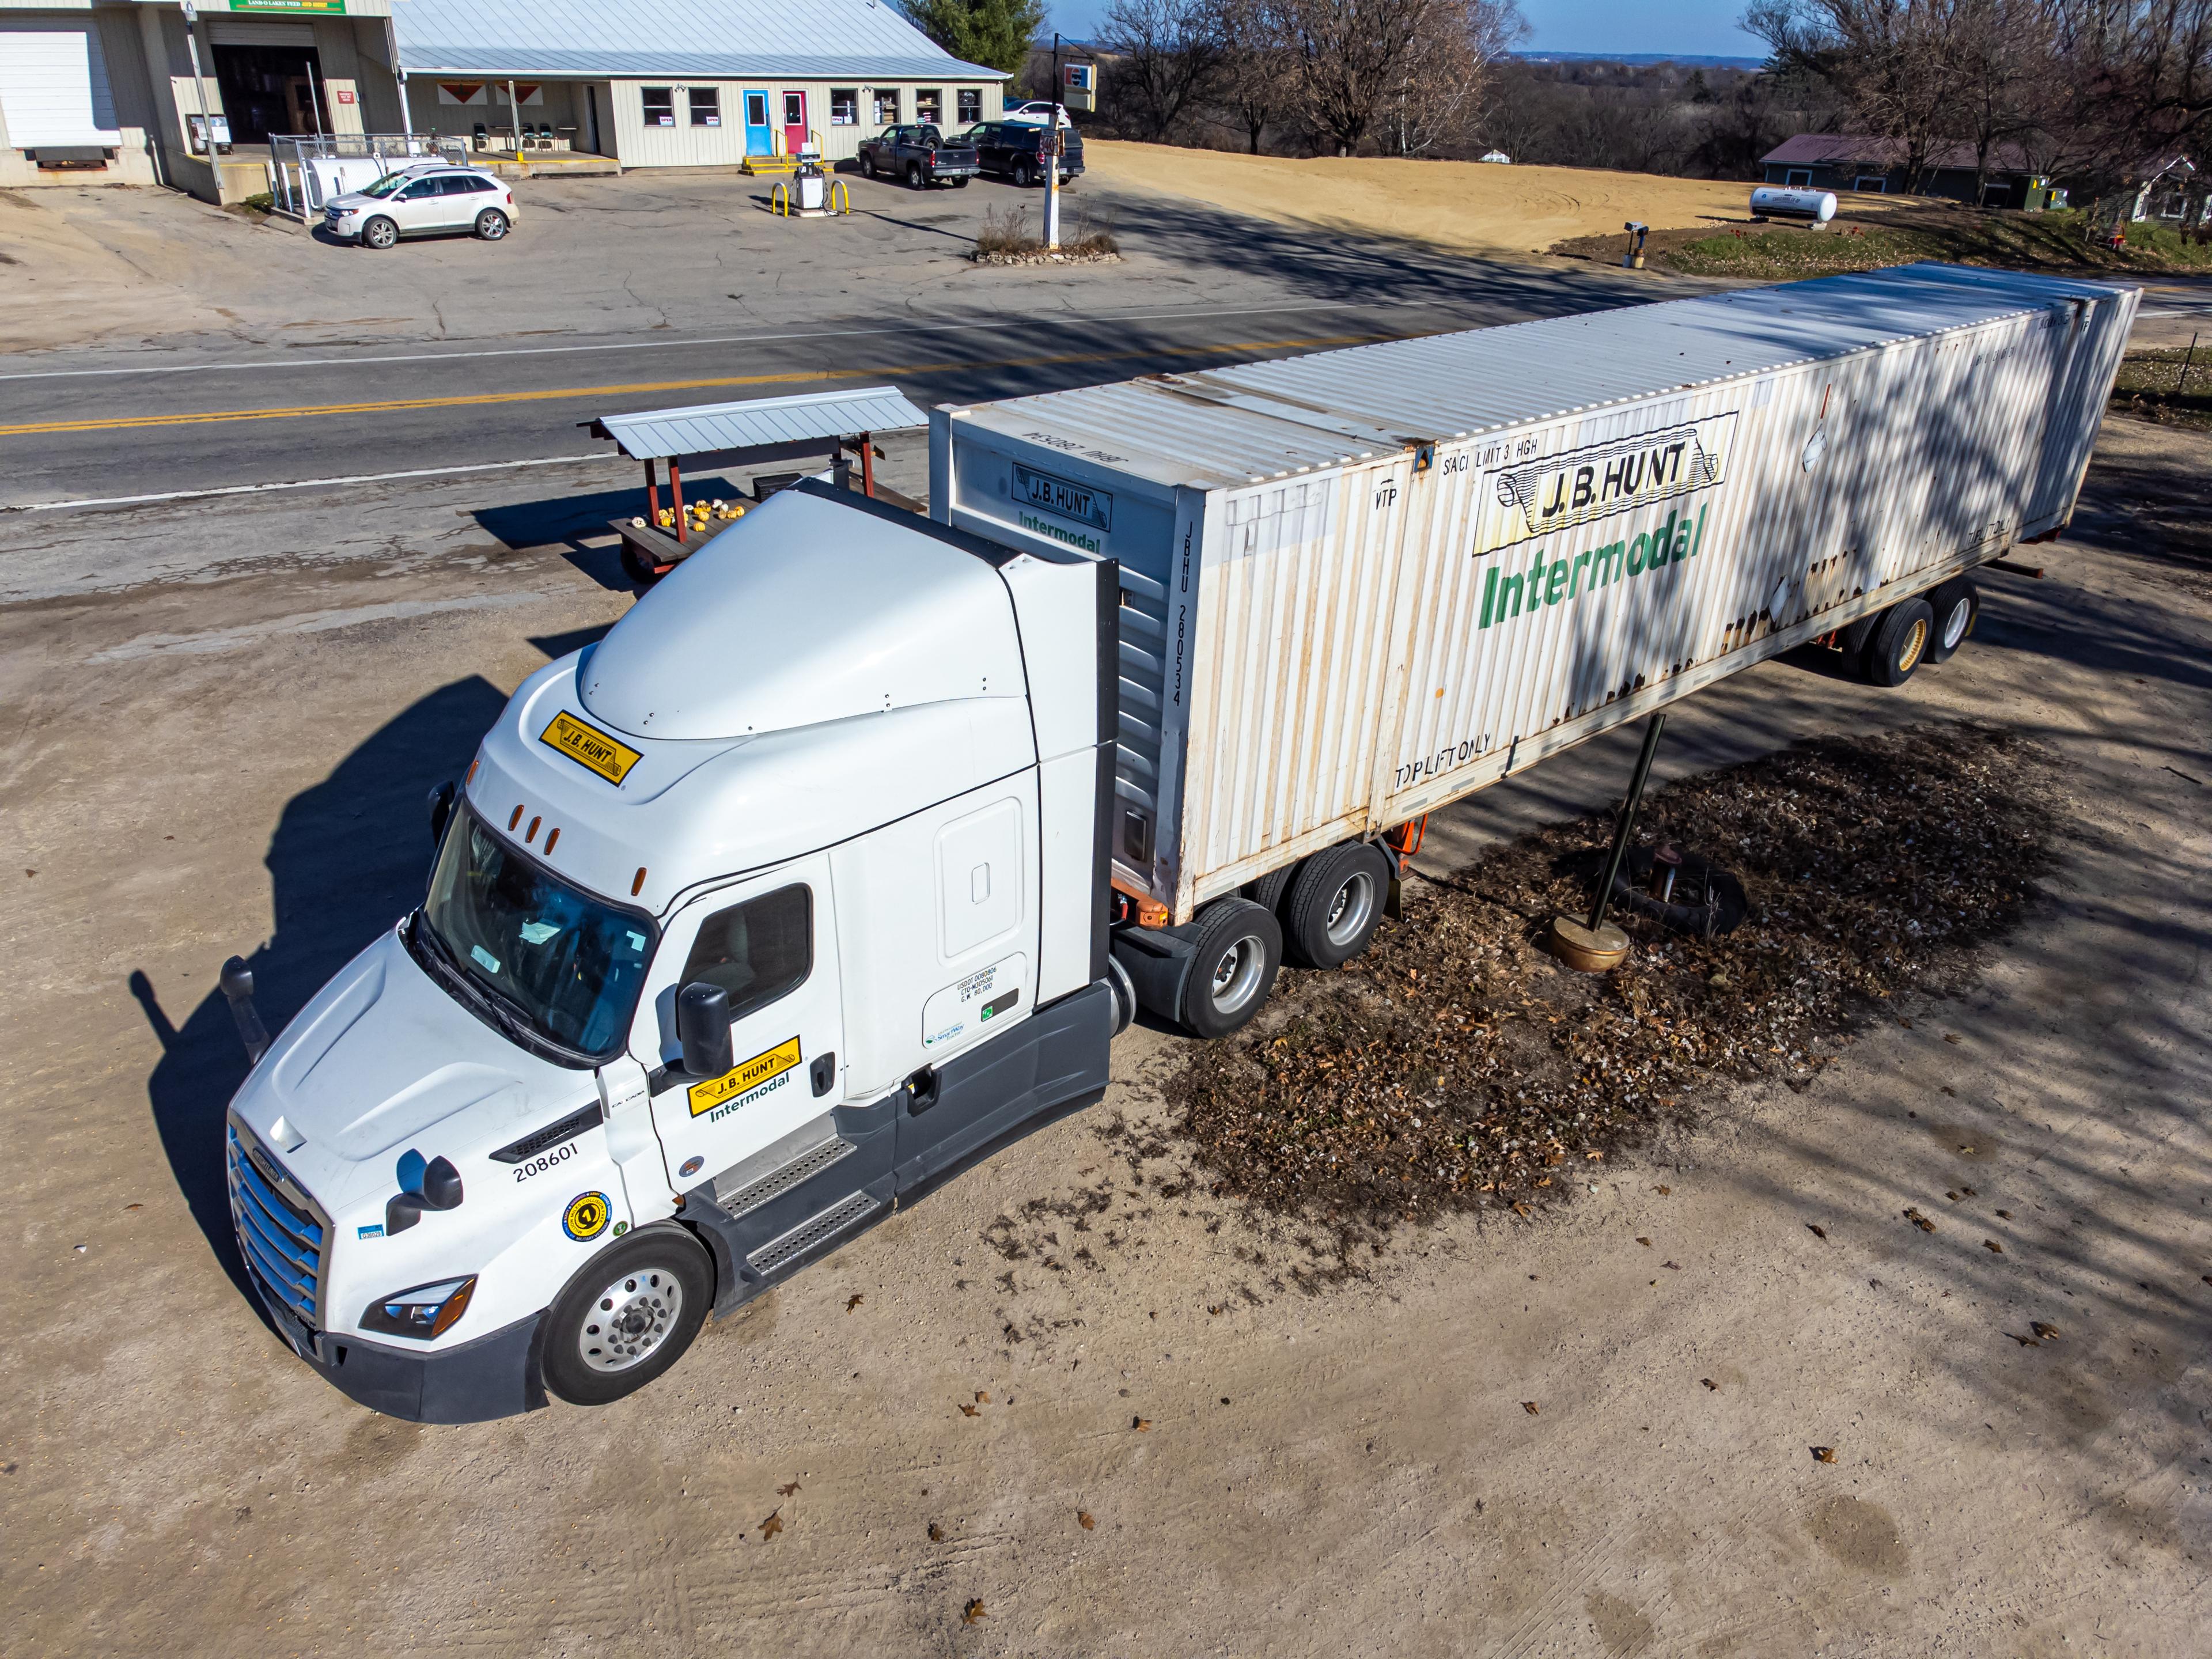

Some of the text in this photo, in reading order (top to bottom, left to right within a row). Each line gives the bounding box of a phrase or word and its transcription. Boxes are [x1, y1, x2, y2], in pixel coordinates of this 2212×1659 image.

[1021, 432, 1129, 463] JBHU 280534
[1503, 444, 1510, 460] 3
[1516, 438, 1537, 458] HGH
[1541, 441, 1686, 518] J.B. HUNT
[1032, 479, 1090, 516] J.B. HUNT
[1376, 488, 1397, 510] VTP
[1018, 511, 1100, 554] Intermodal
[1478, 502, 1707, 630] Intermodal
[1173, 521, 1193, 707] JBHU 280534
[563, 730, 612, 763] J.B. HUNT
[957, 976, 974, 990] USDOT
[974, 982, 993, 996] 80,000
[938, 1023, 964, 1041] SmartWay
[717, 1058, 775, 1094] J.B. HUNT
[710, 1071, 790, 1123] Intermodal
[513, 1142, 578, 1183] 208601
[571, 1203, 581, 1218] MILES
[582, 1199, 604, 1209] COLLISION
[570, 1219, 582, 1234] MILLION
[594, 1221, 609, 1238] VETERAN
